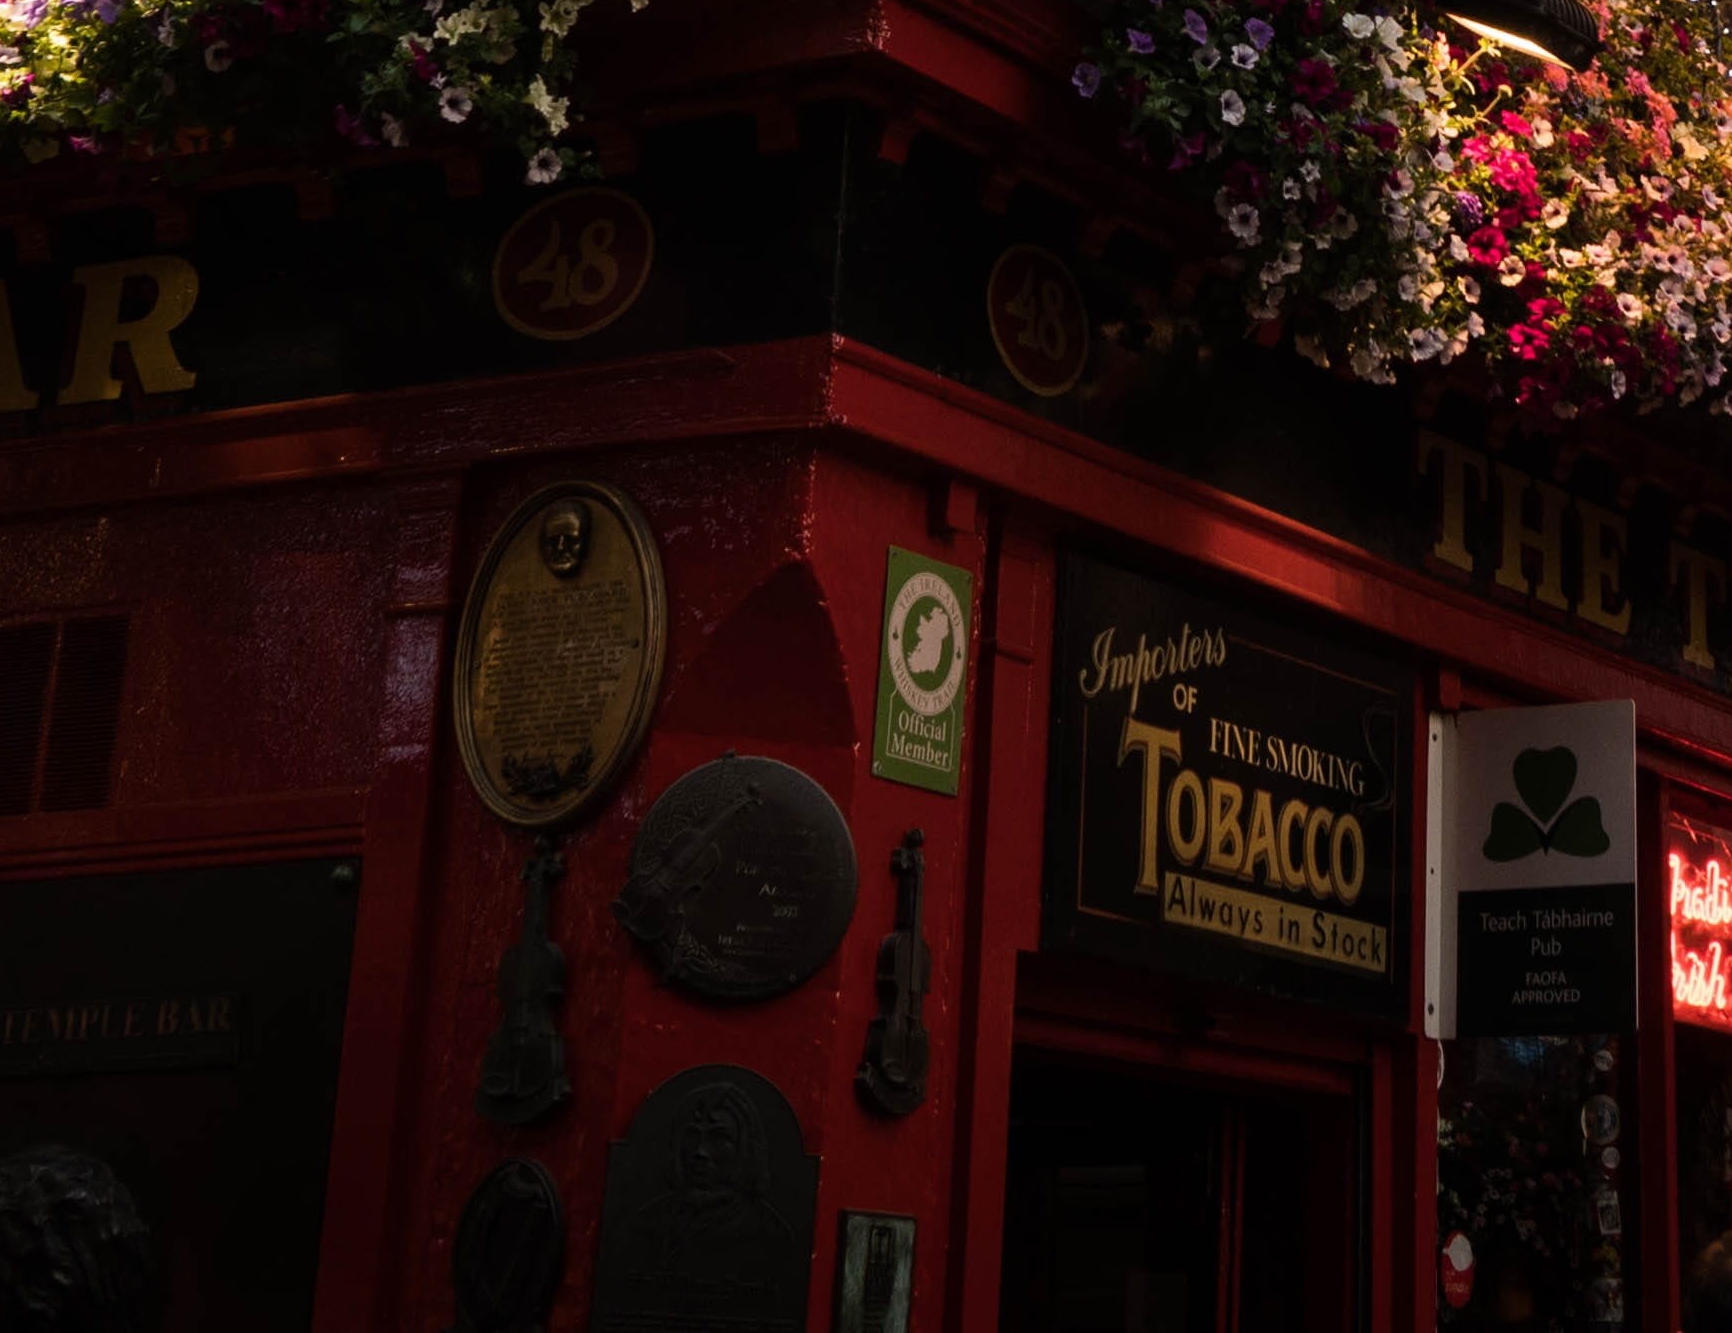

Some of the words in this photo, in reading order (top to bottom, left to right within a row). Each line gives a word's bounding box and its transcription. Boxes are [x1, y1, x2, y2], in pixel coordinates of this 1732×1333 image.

[517, 217, 619, 313] 48
[1004, 265, 1068, 363] 48
[1415, 427, 1634, 636] THE
[898, 584, 916, 611] THE
[920, 578, 962, 627] IRELAND
[894, 658, 929, 711] WHISKEY
[1078, 622, 1228, 715] Importers
[1173, 683, 1198, 714] OF
[891, 732, 950, 767] Member
[898, 709, 947, 742] Official
[1209, 717, 1262, 767] FINE
[1266, 735, 1365, 797] SMOKING
[1117, 714, 1366, 908] TOBACCO
[1167, 875, 1263, 935] Always
[1279, 908, 1300, 943] in
[1313, 911, 1382, 965] Stock
[1478, 908, 1527, 933] Teach
[1530, 934, 1564, 957] Pub
[1670, 931, 1727, 1009] rish
[0, 998, 147, 1047] TEMPLE
[155, 995, 237, 1035] BAR
[1510, 989, 1582, 1006] APPROVED
